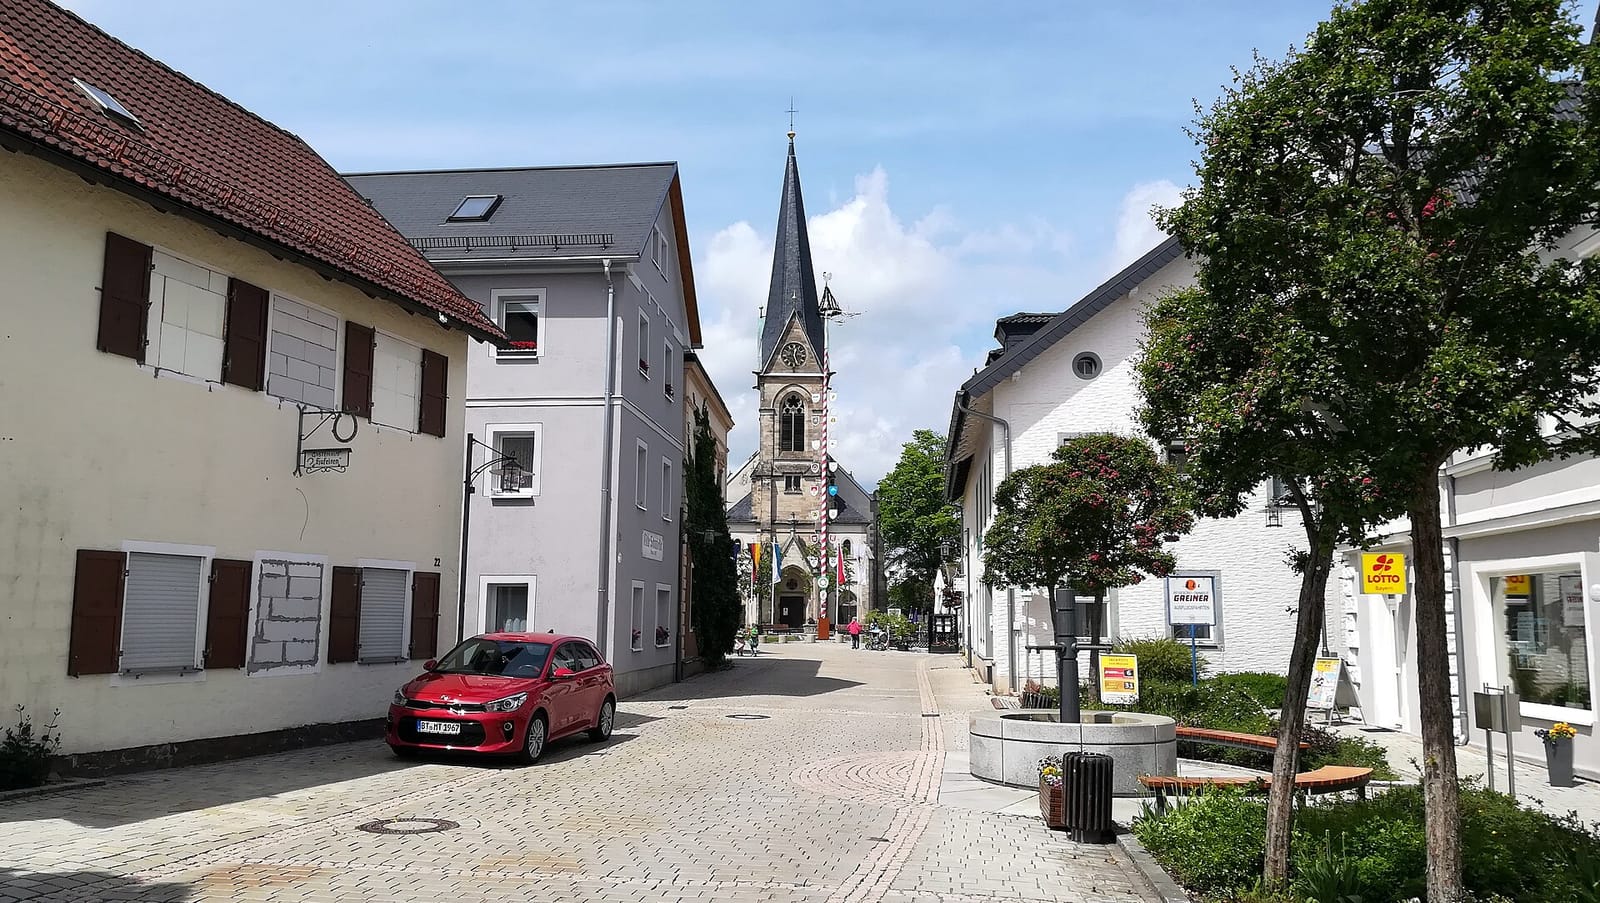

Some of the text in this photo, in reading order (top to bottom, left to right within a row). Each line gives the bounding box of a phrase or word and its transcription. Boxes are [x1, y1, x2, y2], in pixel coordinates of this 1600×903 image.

[434, 557, 441, 567] 22
[1367, 575, 1400, 583] LOTTO
[1173, 594, 1209, 602] GREINER
[421, 721, 429, 729] BT
[443, 724, 460, 732] 1967
